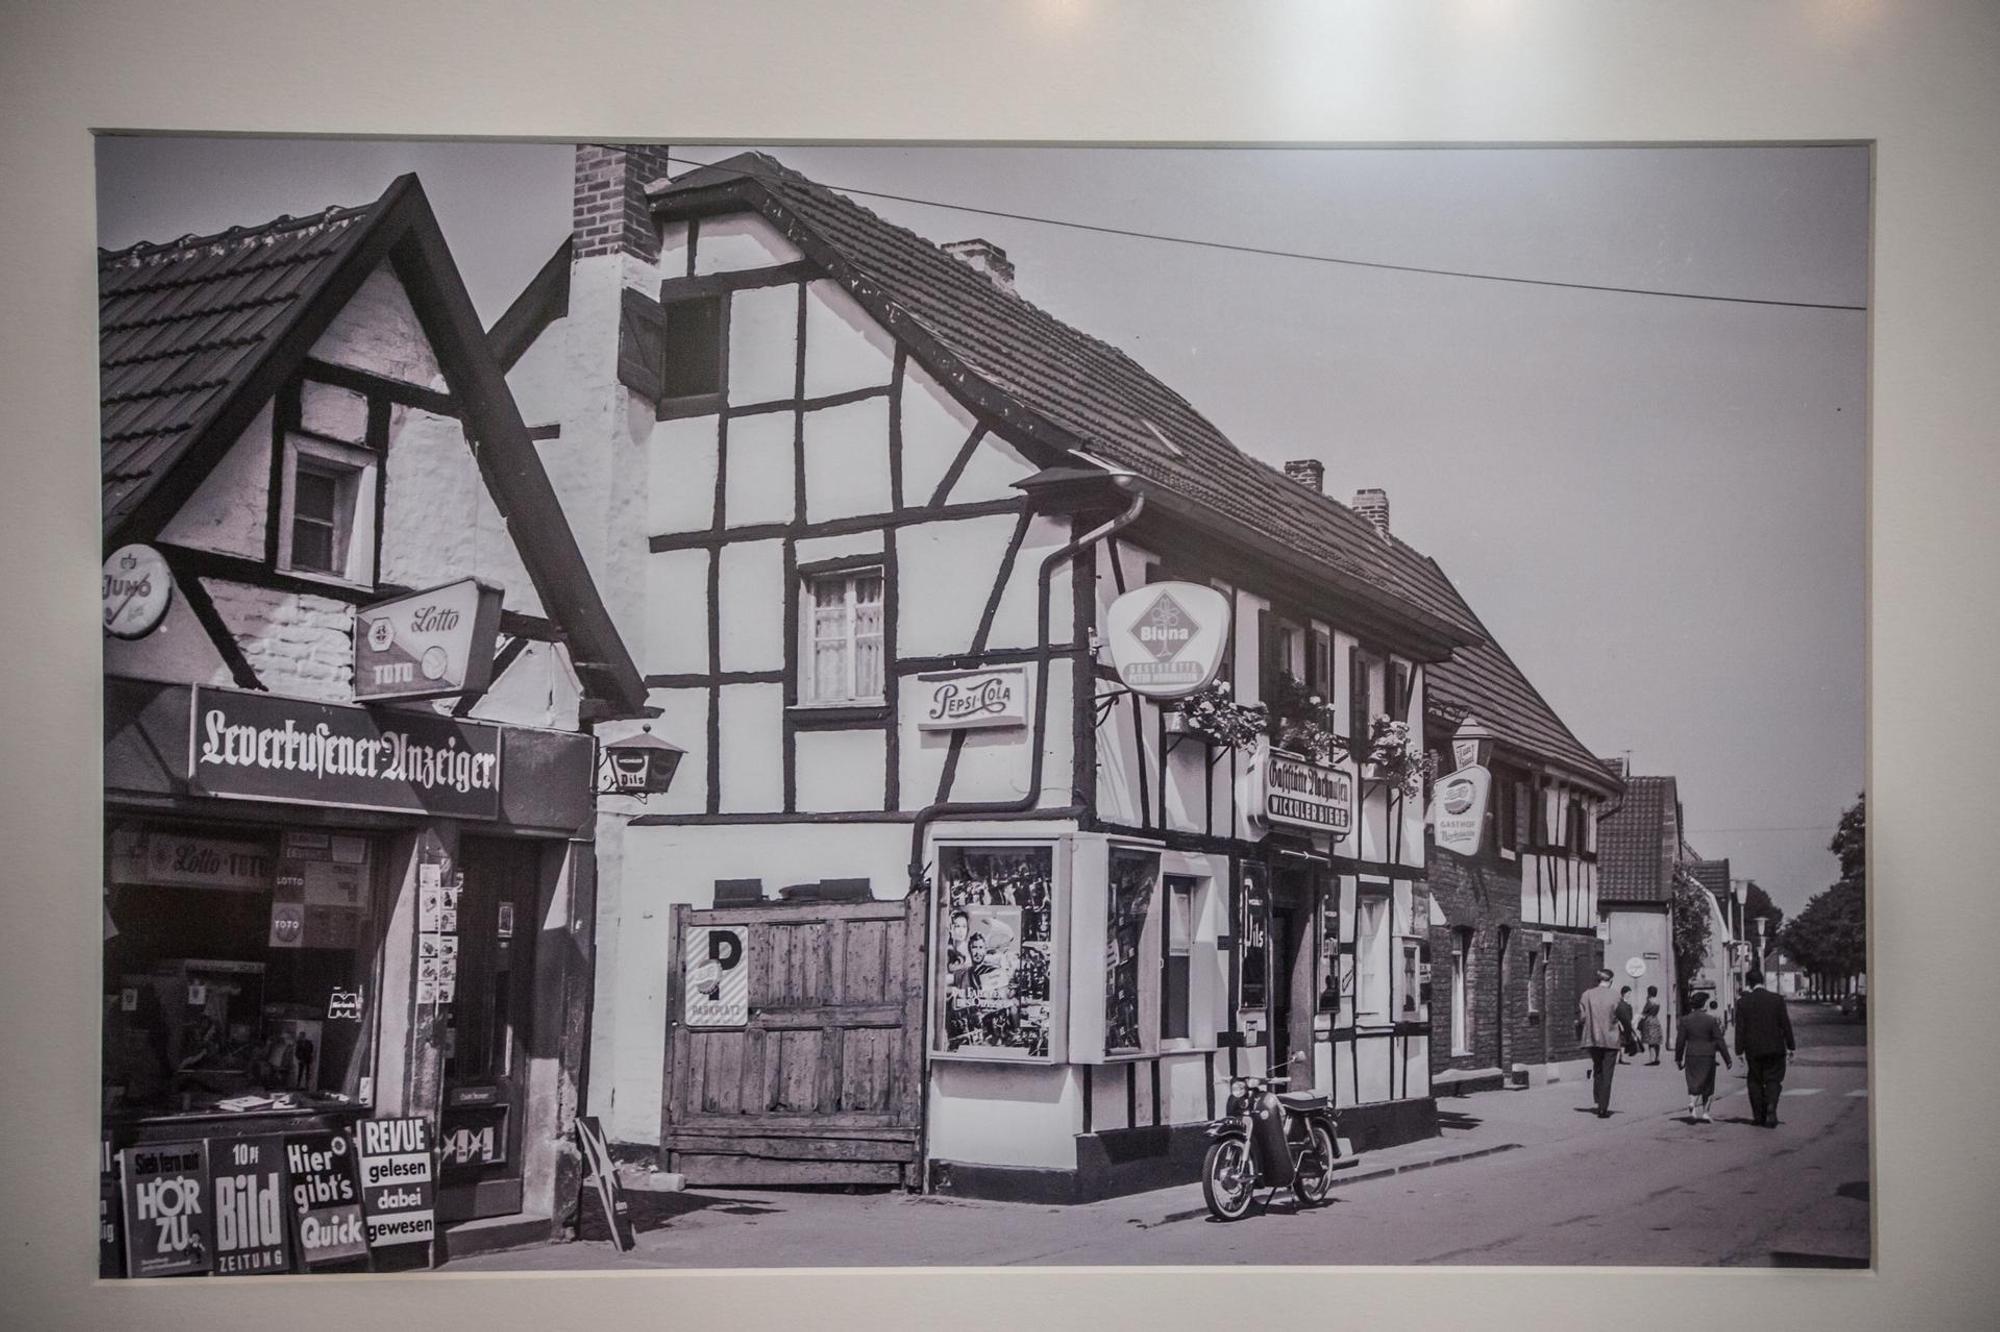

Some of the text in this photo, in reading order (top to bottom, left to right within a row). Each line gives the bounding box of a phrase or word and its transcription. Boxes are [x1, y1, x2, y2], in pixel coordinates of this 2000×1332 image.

[411, 605, 459, 632] Lotto
[1140, 625, 1188, 641] Bluna
[373, 662, 413, 684] TOTO
[621, 773, 645, 786] Pils
[277, 877, 304, 886] LOTTO
[275, 920, 300, 929] TOTO
[709, 930, 742, 1001] P
[365, 1120, 425, 1154] REVUE
[233, 1144, 248, 1165] 10
[287, 1144, 333, 1174] Hier
[369, 1158, 427, 1183] gelesen
[136, 1175, 202, 1220] HÖR
[294, 1174, 353, 1214] gibt's
[378, 1187, 422, 1209] dabei
[215, 1172, 282, 1251] Bild
[155, 1215, 188, 1253] ZU
[301, 1213, 364, 1249] Quick
[367, 1219, 433, 1242] gewesen
[218, 1250, 283, 1273] ZEITUNG
